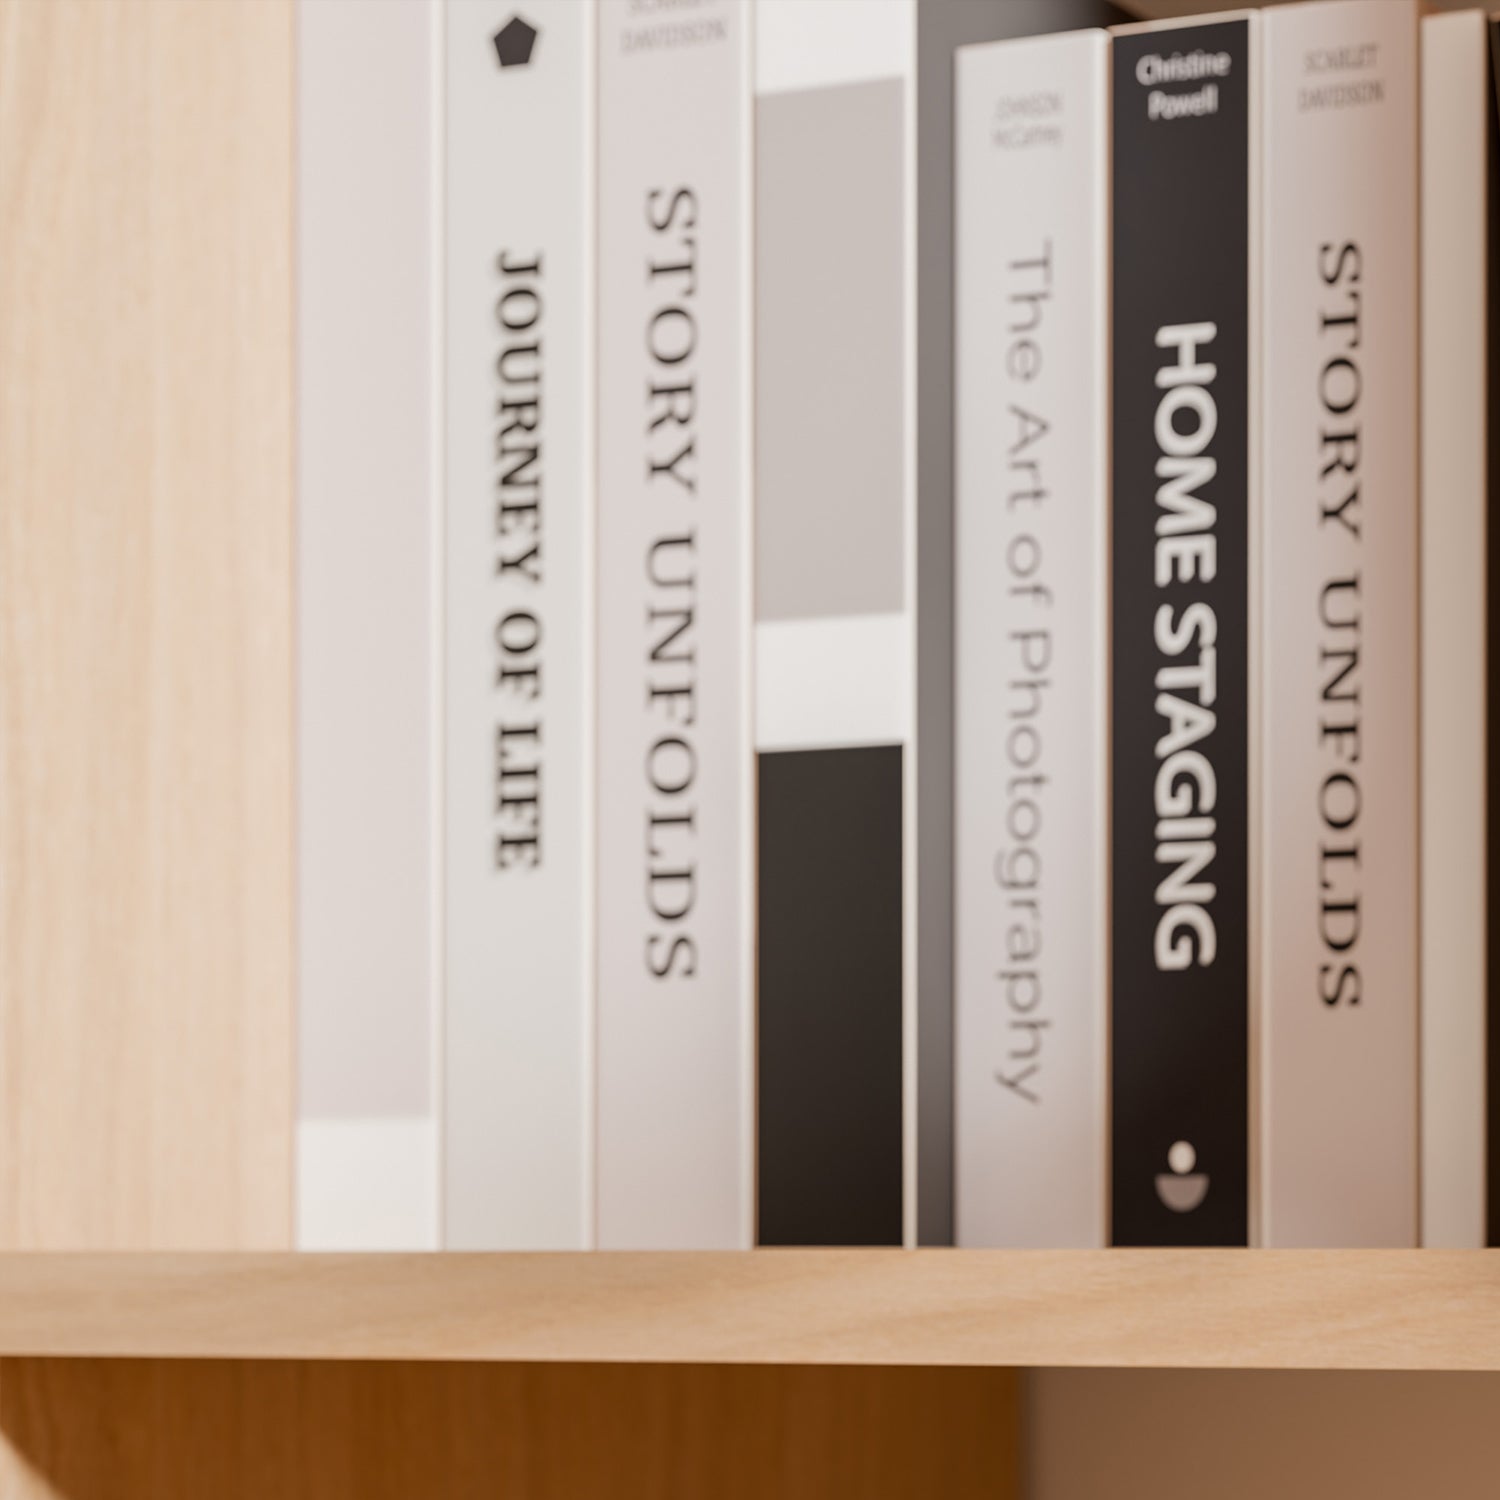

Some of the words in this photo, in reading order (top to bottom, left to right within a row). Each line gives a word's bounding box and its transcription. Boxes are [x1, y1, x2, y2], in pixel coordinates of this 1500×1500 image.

[1134, 49, 1232, 87] Christine
[1147, 83, 1219, 121] Powell
[496, 246, 541, 584] JOURNEY
[646, 184, 697, 493] STORY
[1005, 233, 1054, 385] The
[1317, 239, 1363, 548] STORY
[1005, 402, 1051, 517] Art
[1005, 531, 1054, 608] of
[1153, 320, 1219, 589] HOME
[496, 608, 541, 701] OF
[646, 529, 697, 983] UNFOLDS
[1153, 601, 1219, 972] STAGING
[496, 720, 541, 874] LIFE
[994, 626, 1054, 1106] Photography
[1317, 571, 1363, 1010] UNFOLDS
